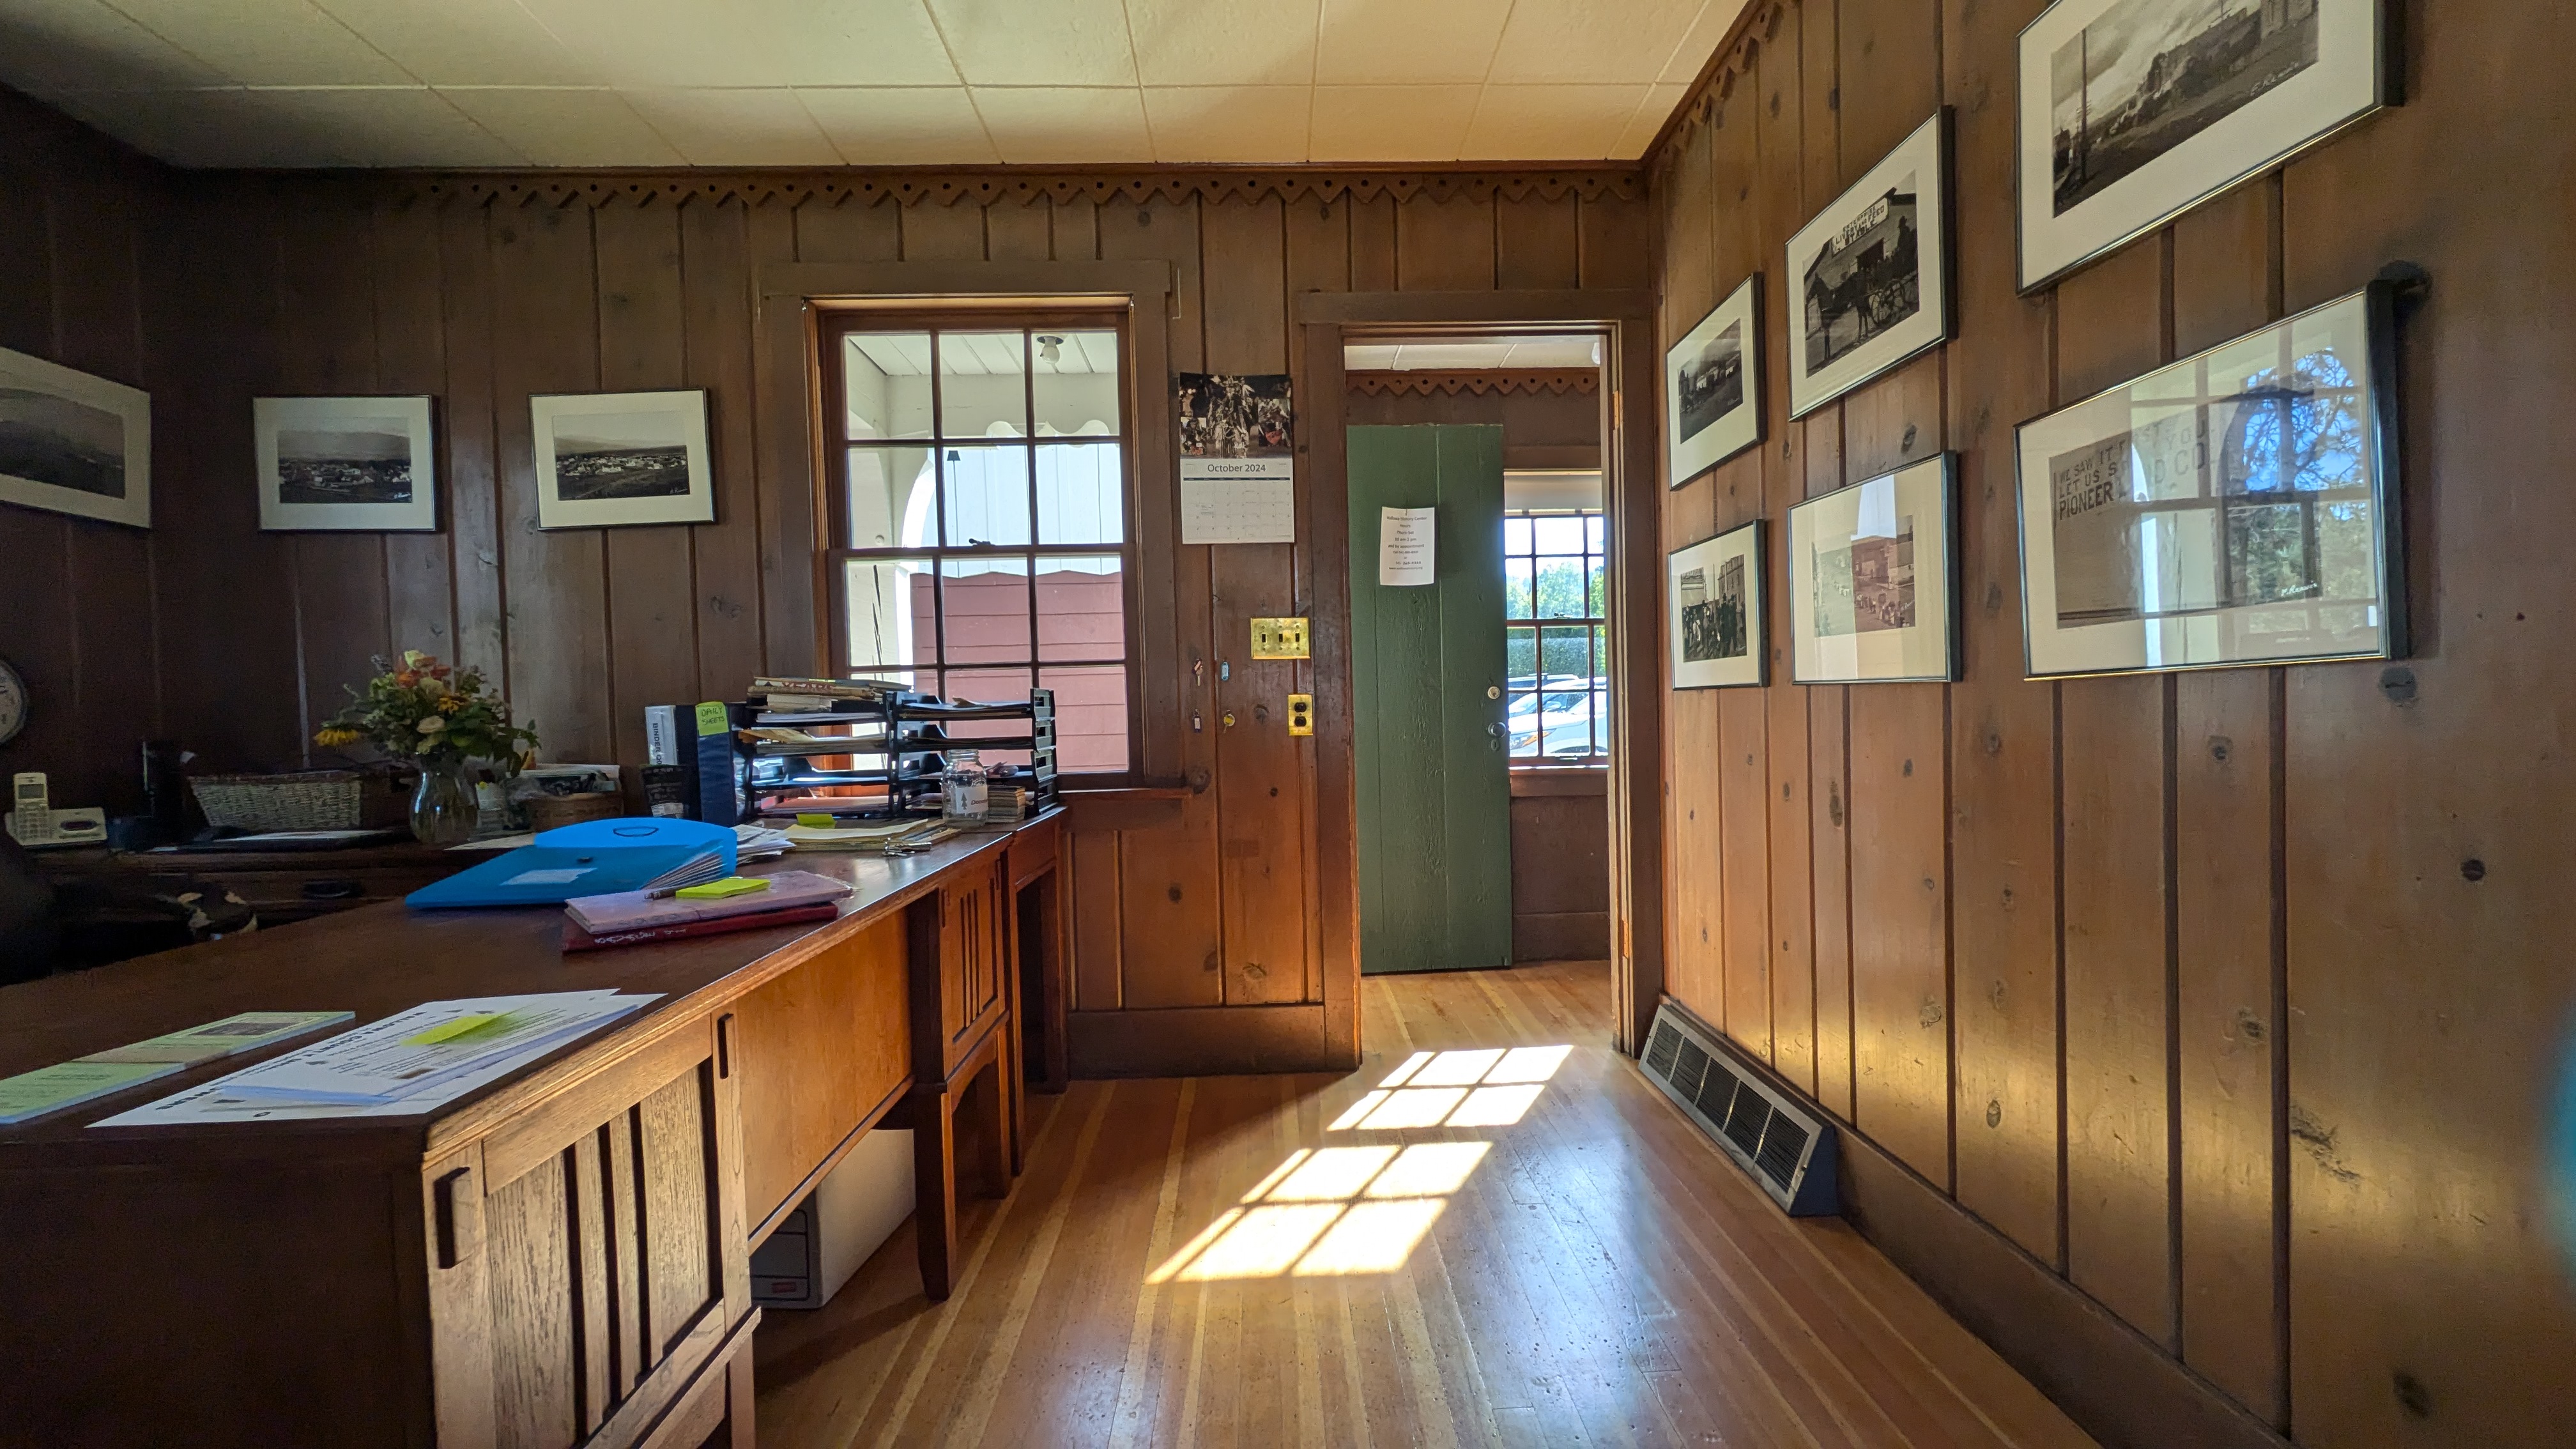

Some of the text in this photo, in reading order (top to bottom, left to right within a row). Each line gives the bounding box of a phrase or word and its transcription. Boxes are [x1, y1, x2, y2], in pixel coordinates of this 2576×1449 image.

[1868, 204, 1885, 222] FEED
[1208, 463, 1266, 473] October 2024
[2074, 458, 2093, 477] SAW
[2059, 478, 2080, 499] LET
[2085, 469, 2100, 487] US
[2059, 481, 2114, 520] PIONEER
[701, 706, 723, 717] DAILY
[701, 716, 725, 726] SHEETS
[652, 723, 661, 753] BINDER
